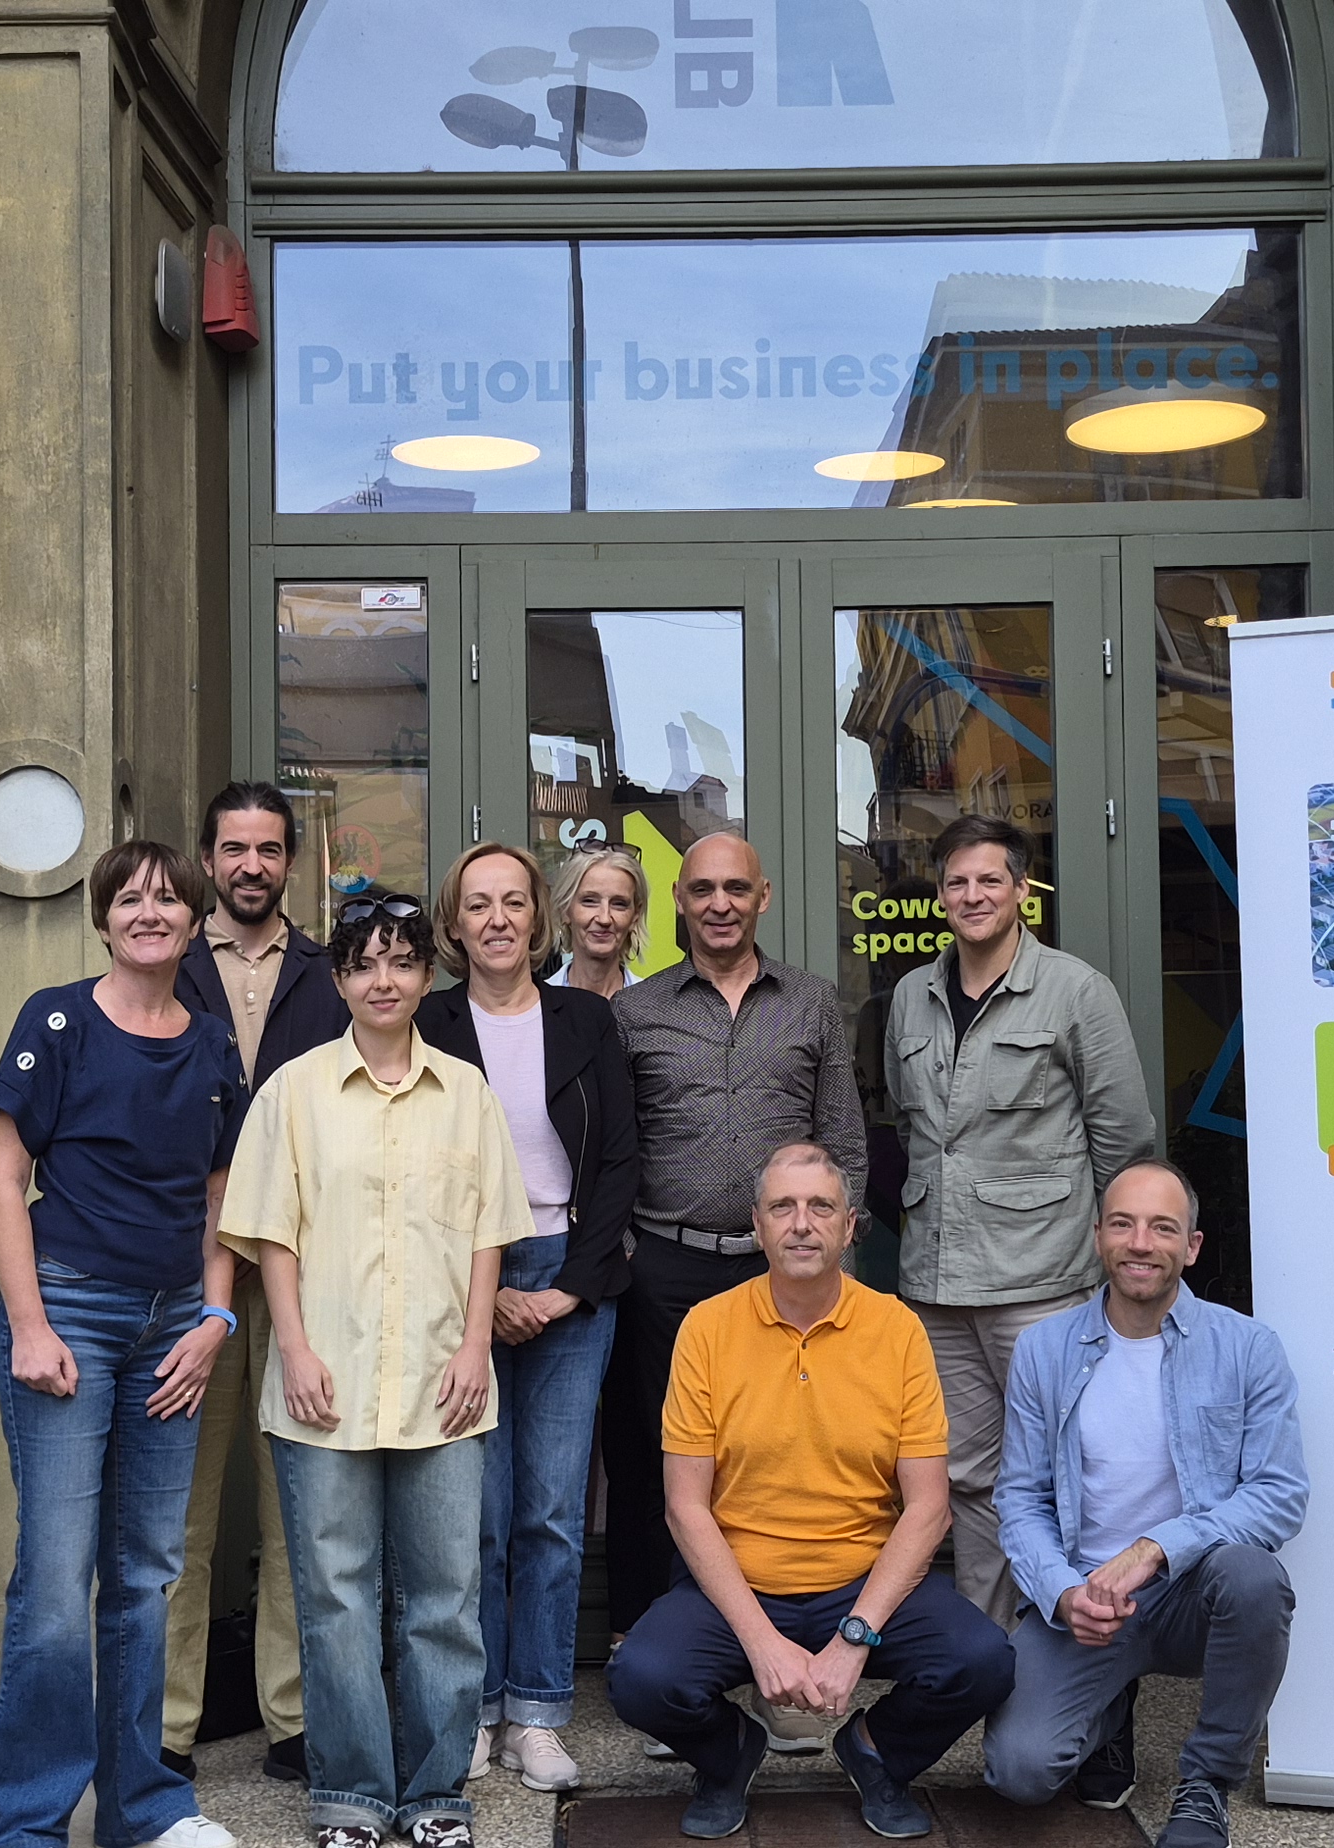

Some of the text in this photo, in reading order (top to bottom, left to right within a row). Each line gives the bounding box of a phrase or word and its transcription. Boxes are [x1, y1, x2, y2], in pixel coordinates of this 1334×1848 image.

[299, 331, 1279, 421] Put your business in place.
[852, 931, 957, 960] space
